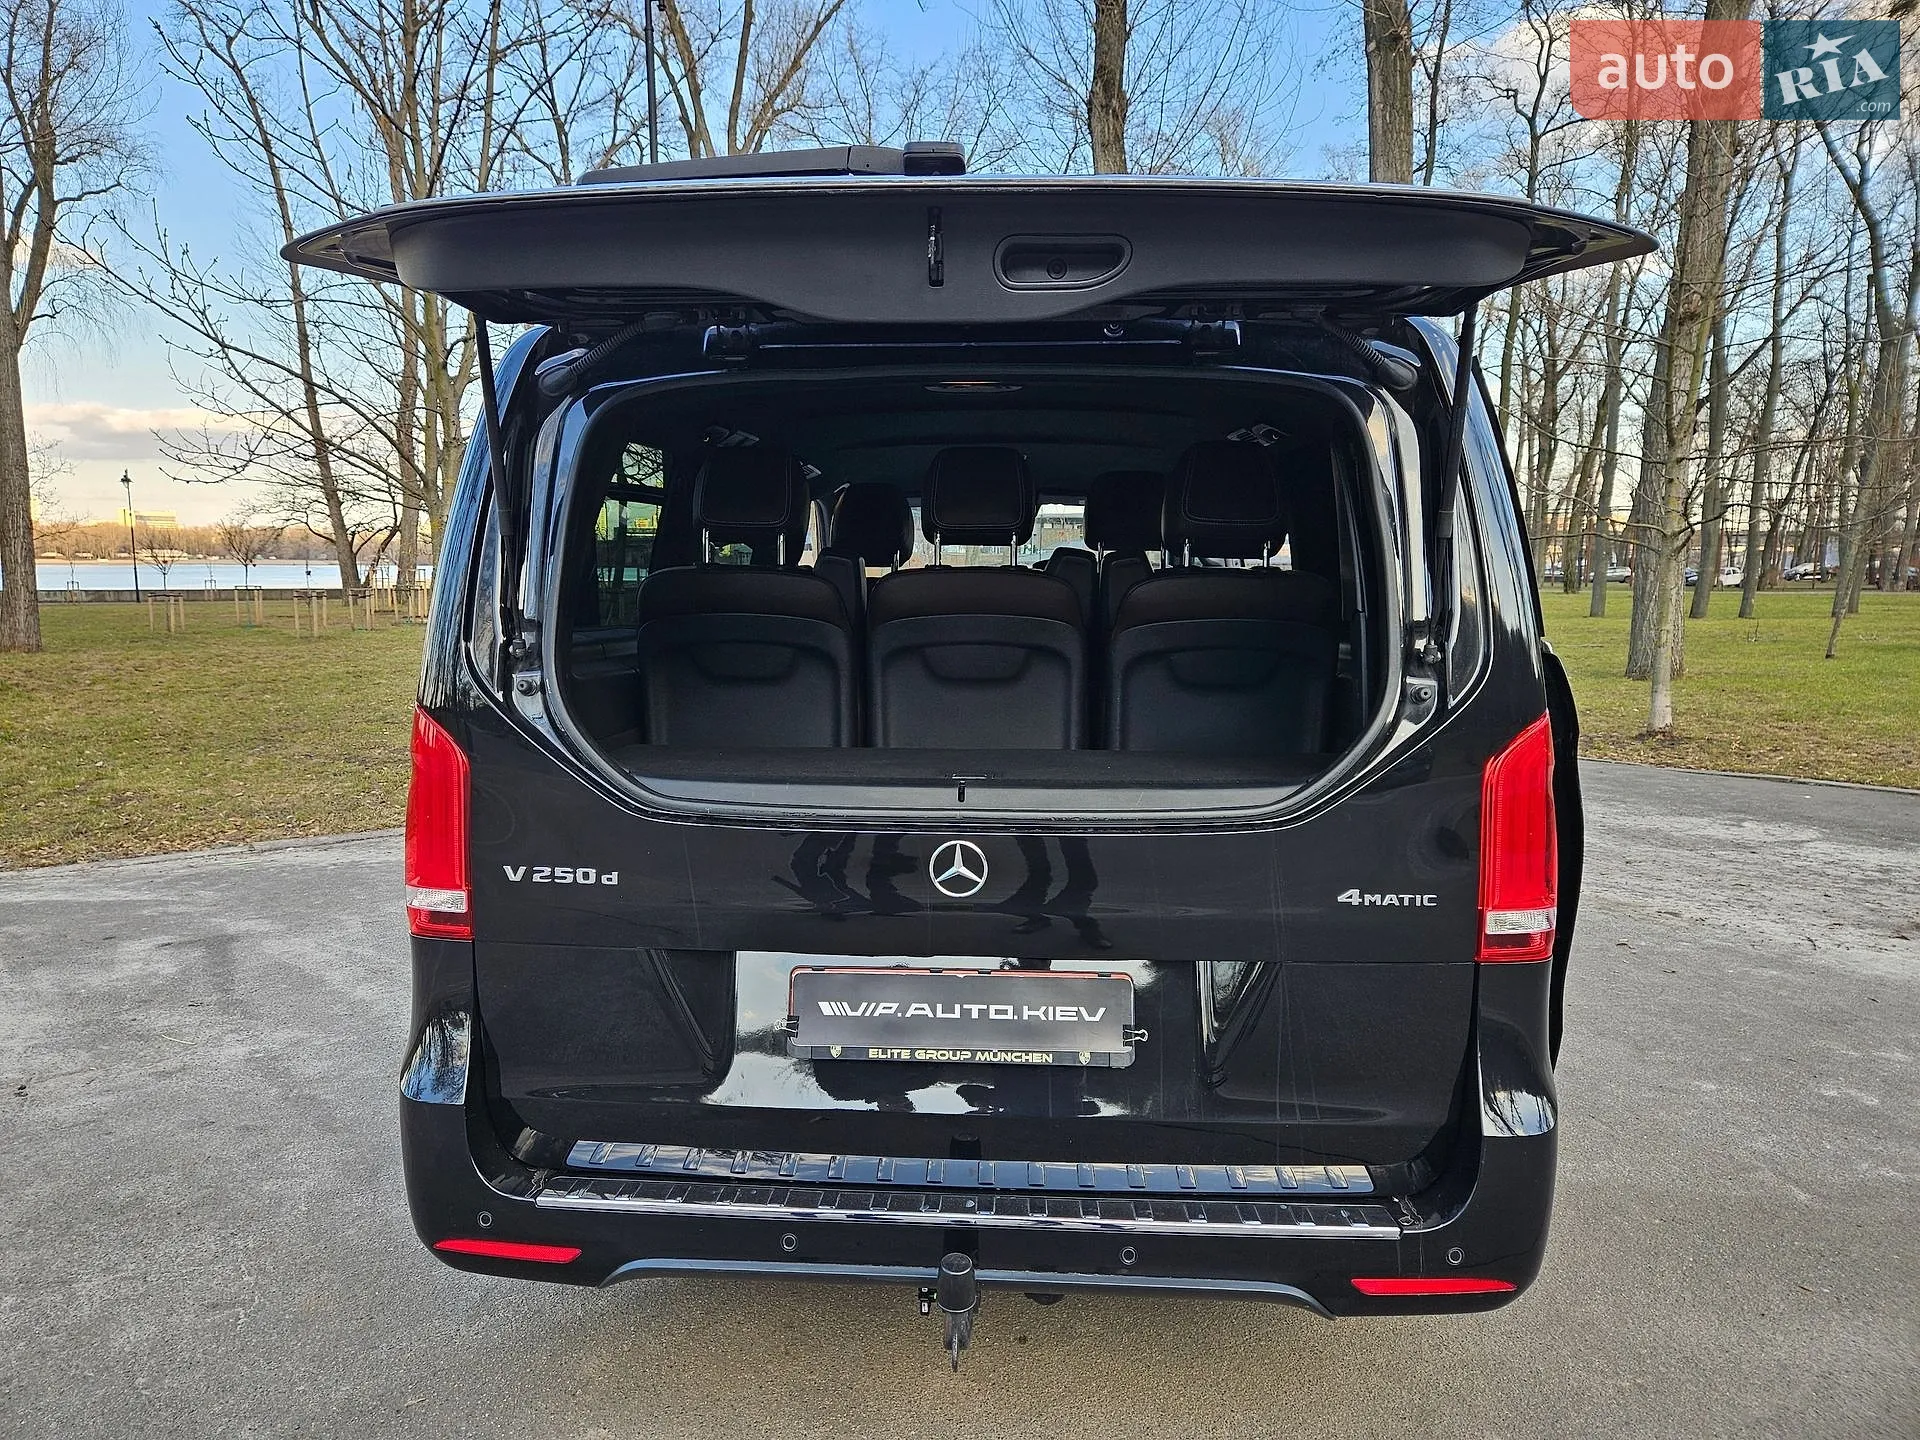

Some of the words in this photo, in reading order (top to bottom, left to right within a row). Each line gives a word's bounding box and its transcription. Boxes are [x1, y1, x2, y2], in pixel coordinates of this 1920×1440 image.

[1337, 888, 1437, 907] 4MATIC
[868, 1048, 911, 1060] ELITE
[914, 1049, 971, 1062] GROUP
[975, 1049, 1053, 1063] MÜNCHEN
